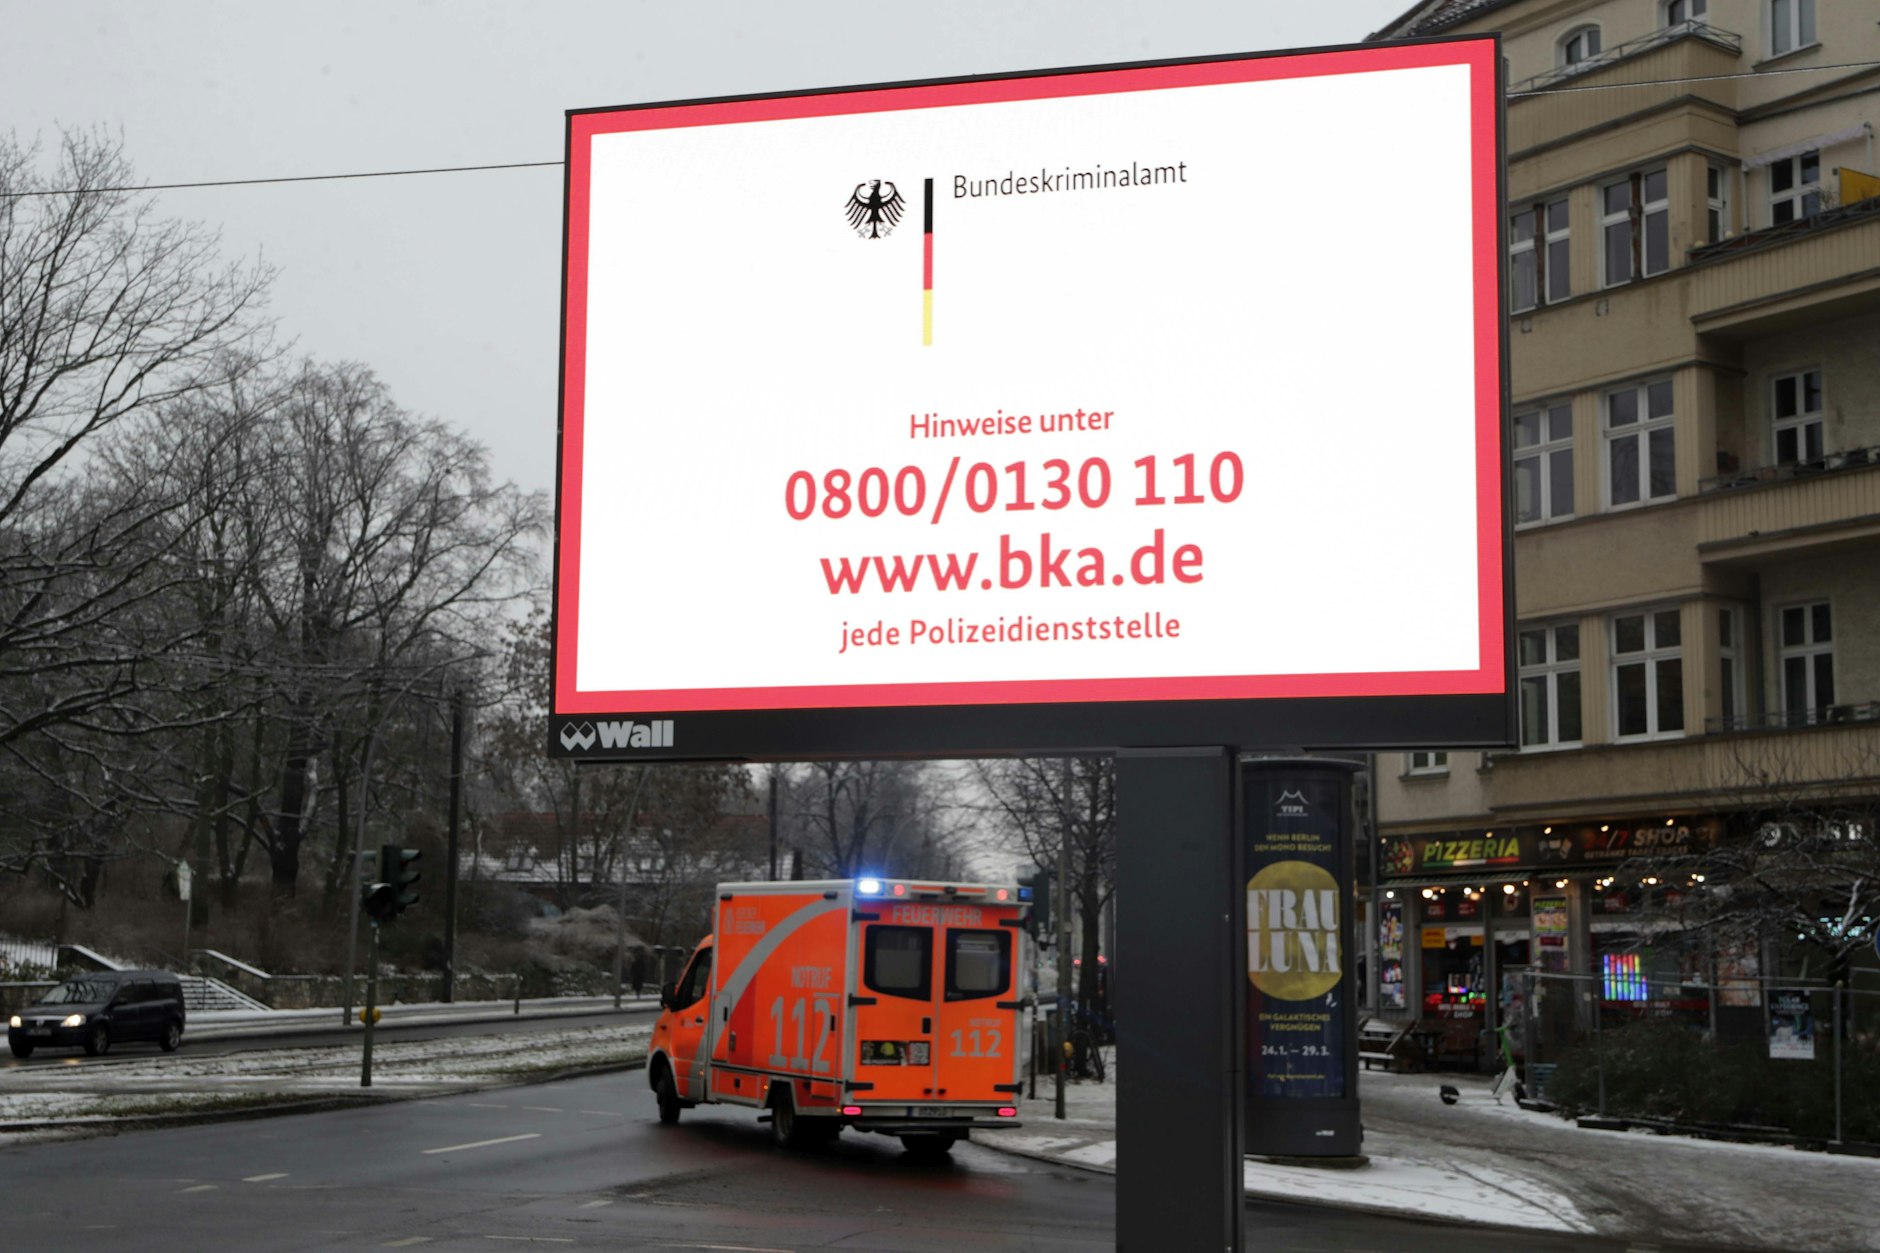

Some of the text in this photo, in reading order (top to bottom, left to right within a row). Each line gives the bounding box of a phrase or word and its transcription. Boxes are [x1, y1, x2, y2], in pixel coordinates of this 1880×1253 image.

[954, 161, 1187, 199] Bundeskriminalamt
[910, 408, 1115, 439] Hinweise unter
[785, 451, 1245, 525] 0800/0130 110
[820, 528, 1204, 595] www.bka.de
[839, 611, 1181, 654] jede Polizeidienststelle
[596, 719, 675, 749] Wall
[1281, 805, 1304, 813] TIPI
[1265, 833, 1320, 842] WENN BERLIN
[1297, 843, 1332, 852] BESUCHT
[1423, 837, 1520, 862] PIZZERIA
[1584, 826, 1691, 850] 24/7 SHOP
[892, 905, 982, 927] FEUERWEHR
[1247, 889, 1340, 931] FRAU
[1247, 931, 1342, 973] LUNA
[791, 965, 832, 989] NOTRUF
[1273, 1013, 1331, 1021] GALAKTISCHES
[769, 995, 832, 1073] 112
[951, 1028, 1002, 1057] 112
[1261, 1045, 1288, 1056] 24.1.
[1302, 1045, 1330, 1056] 29.3.
